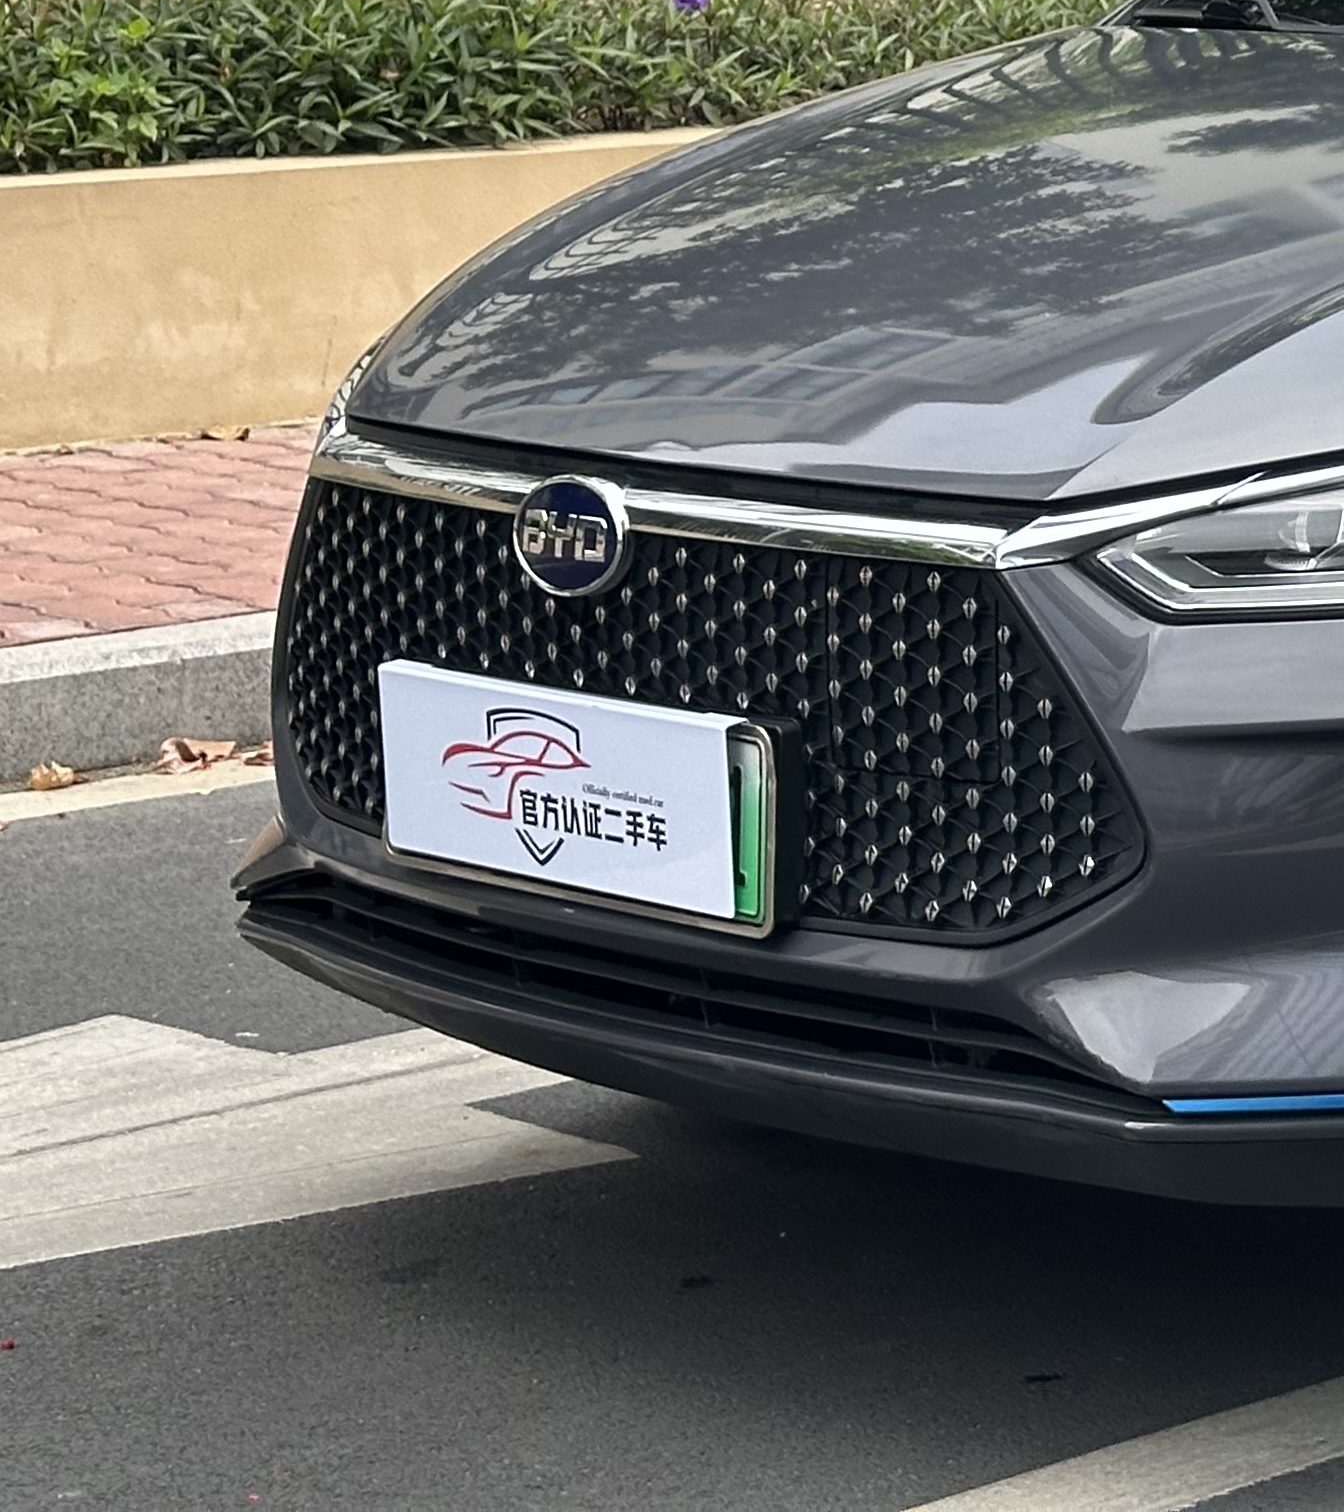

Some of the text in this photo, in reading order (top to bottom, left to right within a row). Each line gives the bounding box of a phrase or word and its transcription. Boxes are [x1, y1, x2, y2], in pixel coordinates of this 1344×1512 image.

[522, 509, 608, 562] BYD
[520, 789, 667, 851] 官方认证二手车
